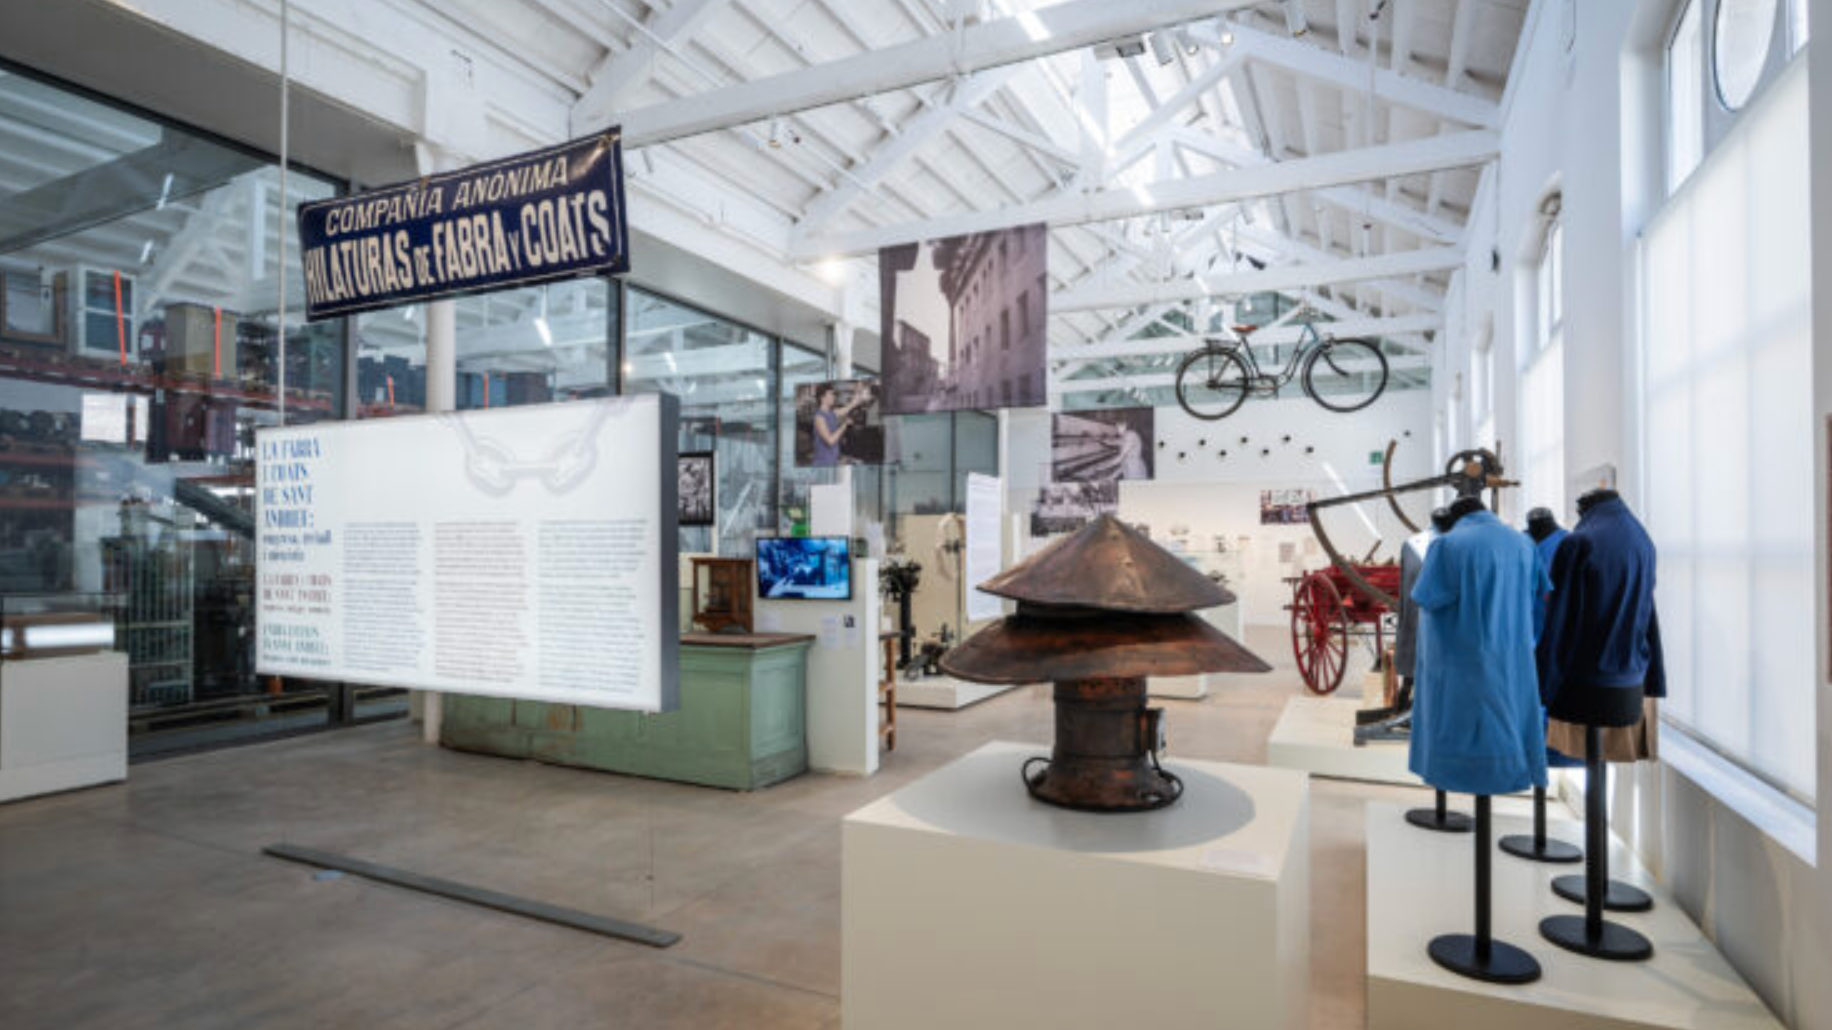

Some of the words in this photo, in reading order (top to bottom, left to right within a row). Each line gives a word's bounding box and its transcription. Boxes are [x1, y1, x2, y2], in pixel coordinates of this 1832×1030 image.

[305, 229, 414, 303] HILATURAS
[413, 245, 436, 286] DE
[432, 210, 511, 283] FABRA
[520, 189, 611, 267] COATS
